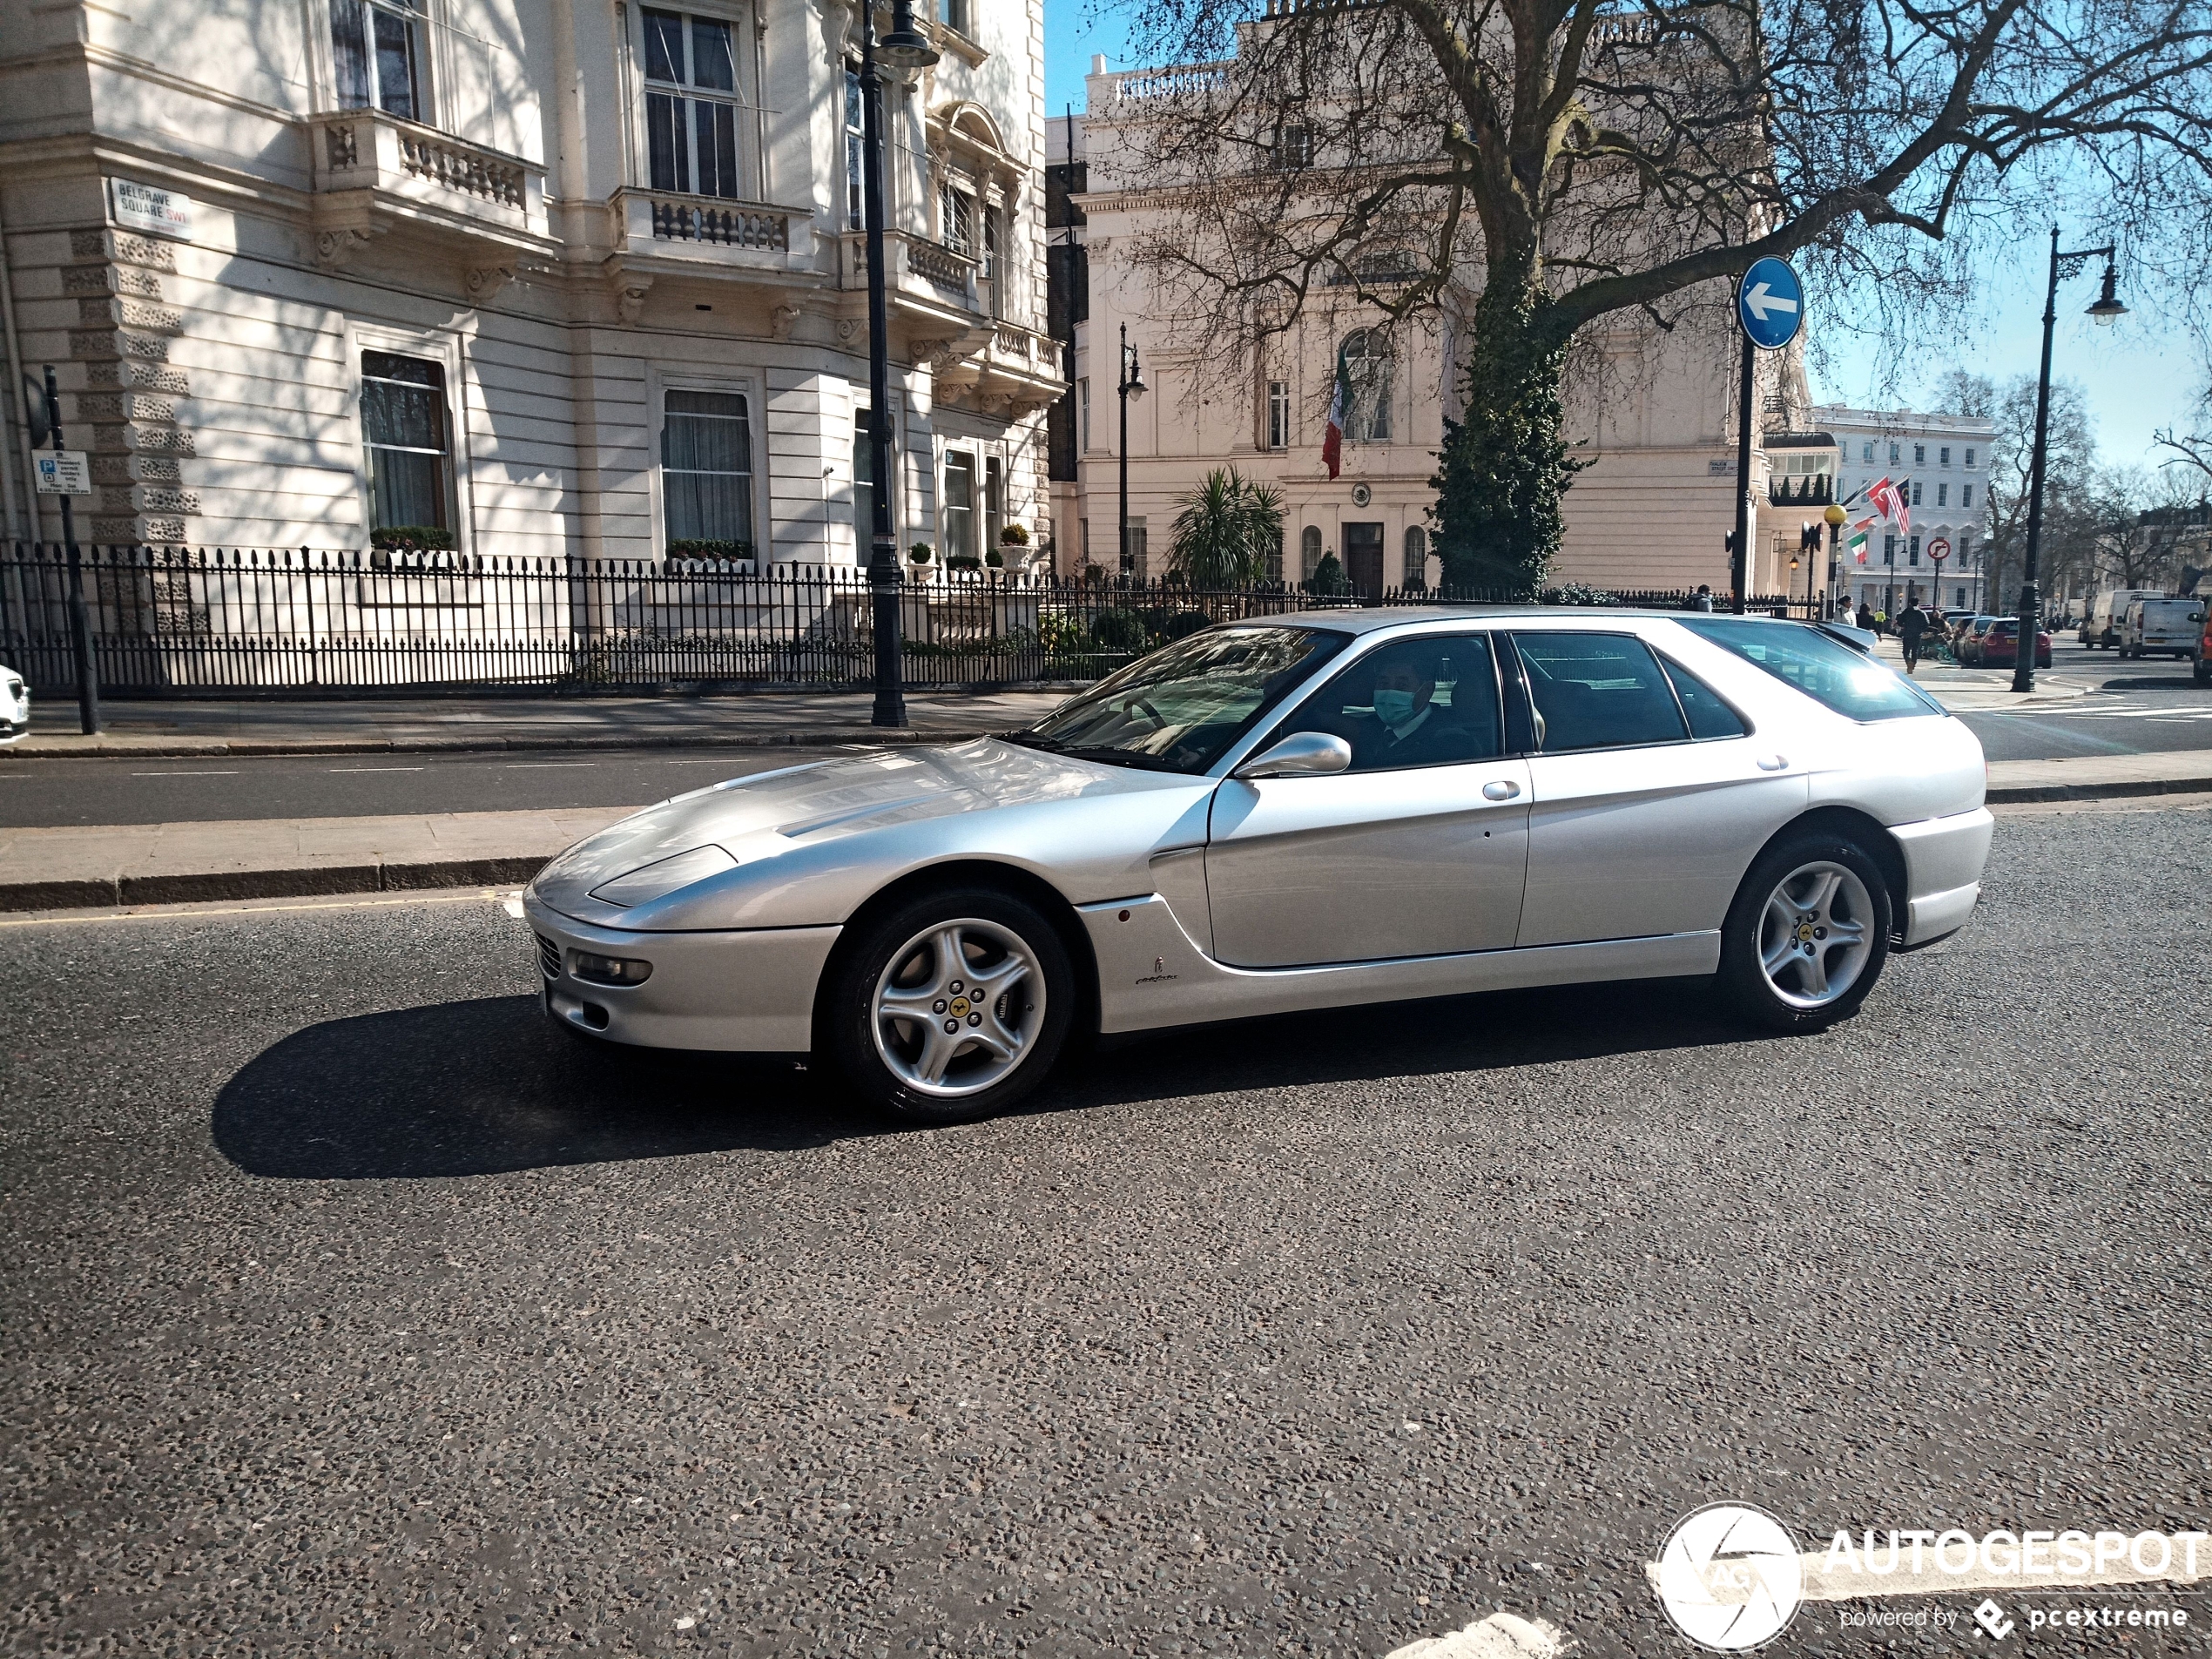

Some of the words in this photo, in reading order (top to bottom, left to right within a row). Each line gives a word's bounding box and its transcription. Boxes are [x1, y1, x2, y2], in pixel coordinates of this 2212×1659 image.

[118, 184, 170, 206] BELGRAVE
[121, 198, 163, 218] SQUARE
[166, 209, 186, 223] SW1
[43, 461, 52, 471] P
